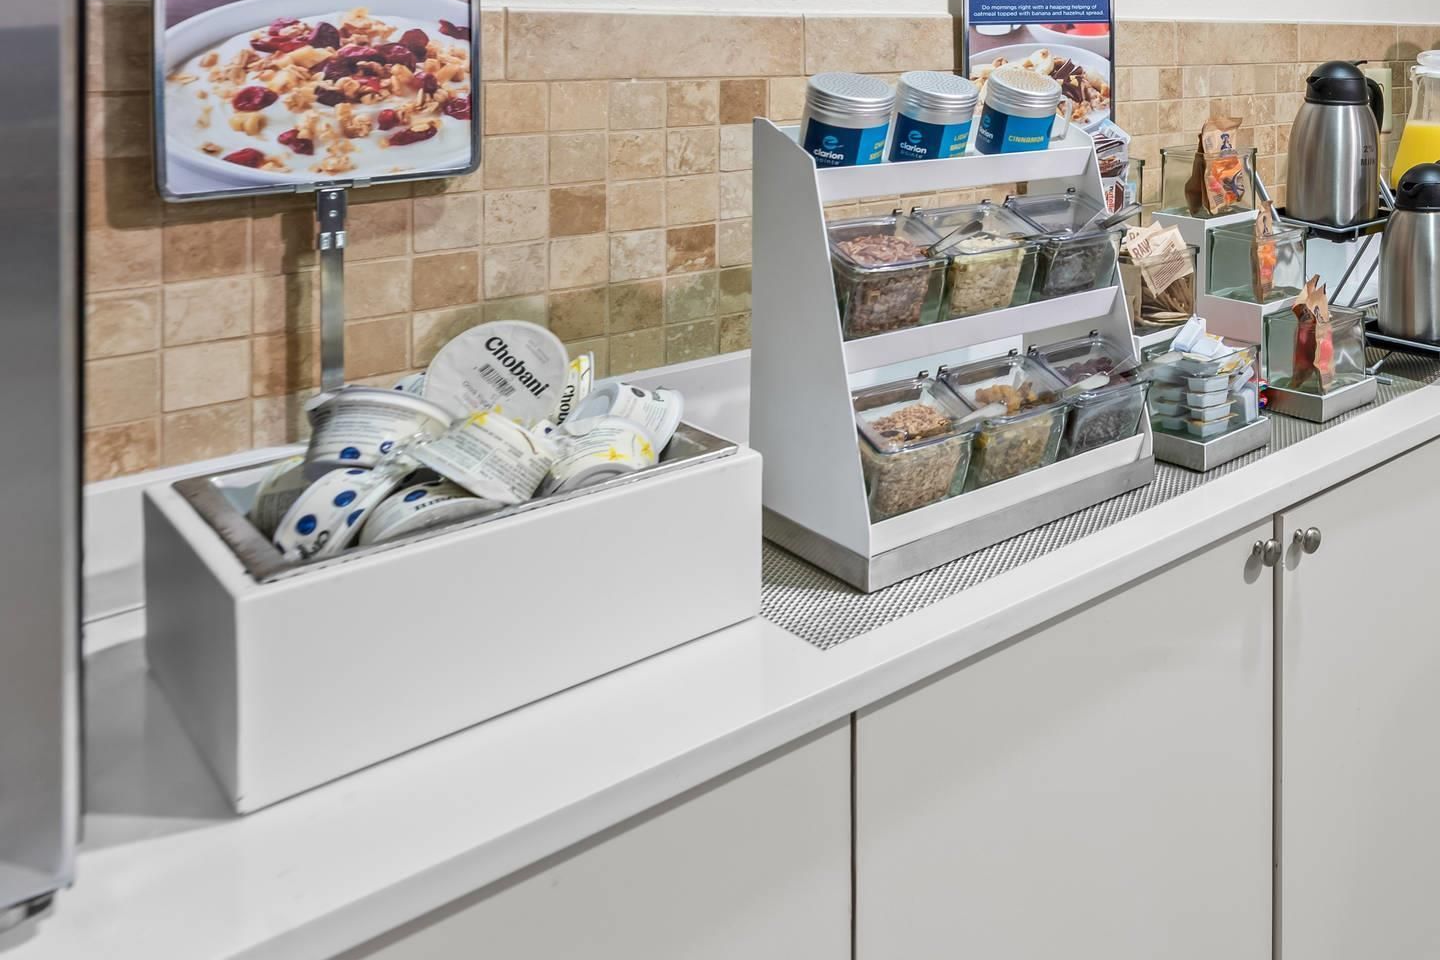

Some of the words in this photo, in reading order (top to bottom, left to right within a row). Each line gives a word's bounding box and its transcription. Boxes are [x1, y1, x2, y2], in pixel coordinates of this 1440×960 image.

[900, 141, 928, 154] clarion
[813, 148, 845, 161] clarion
[484, 336, 551, 398] Chobani
